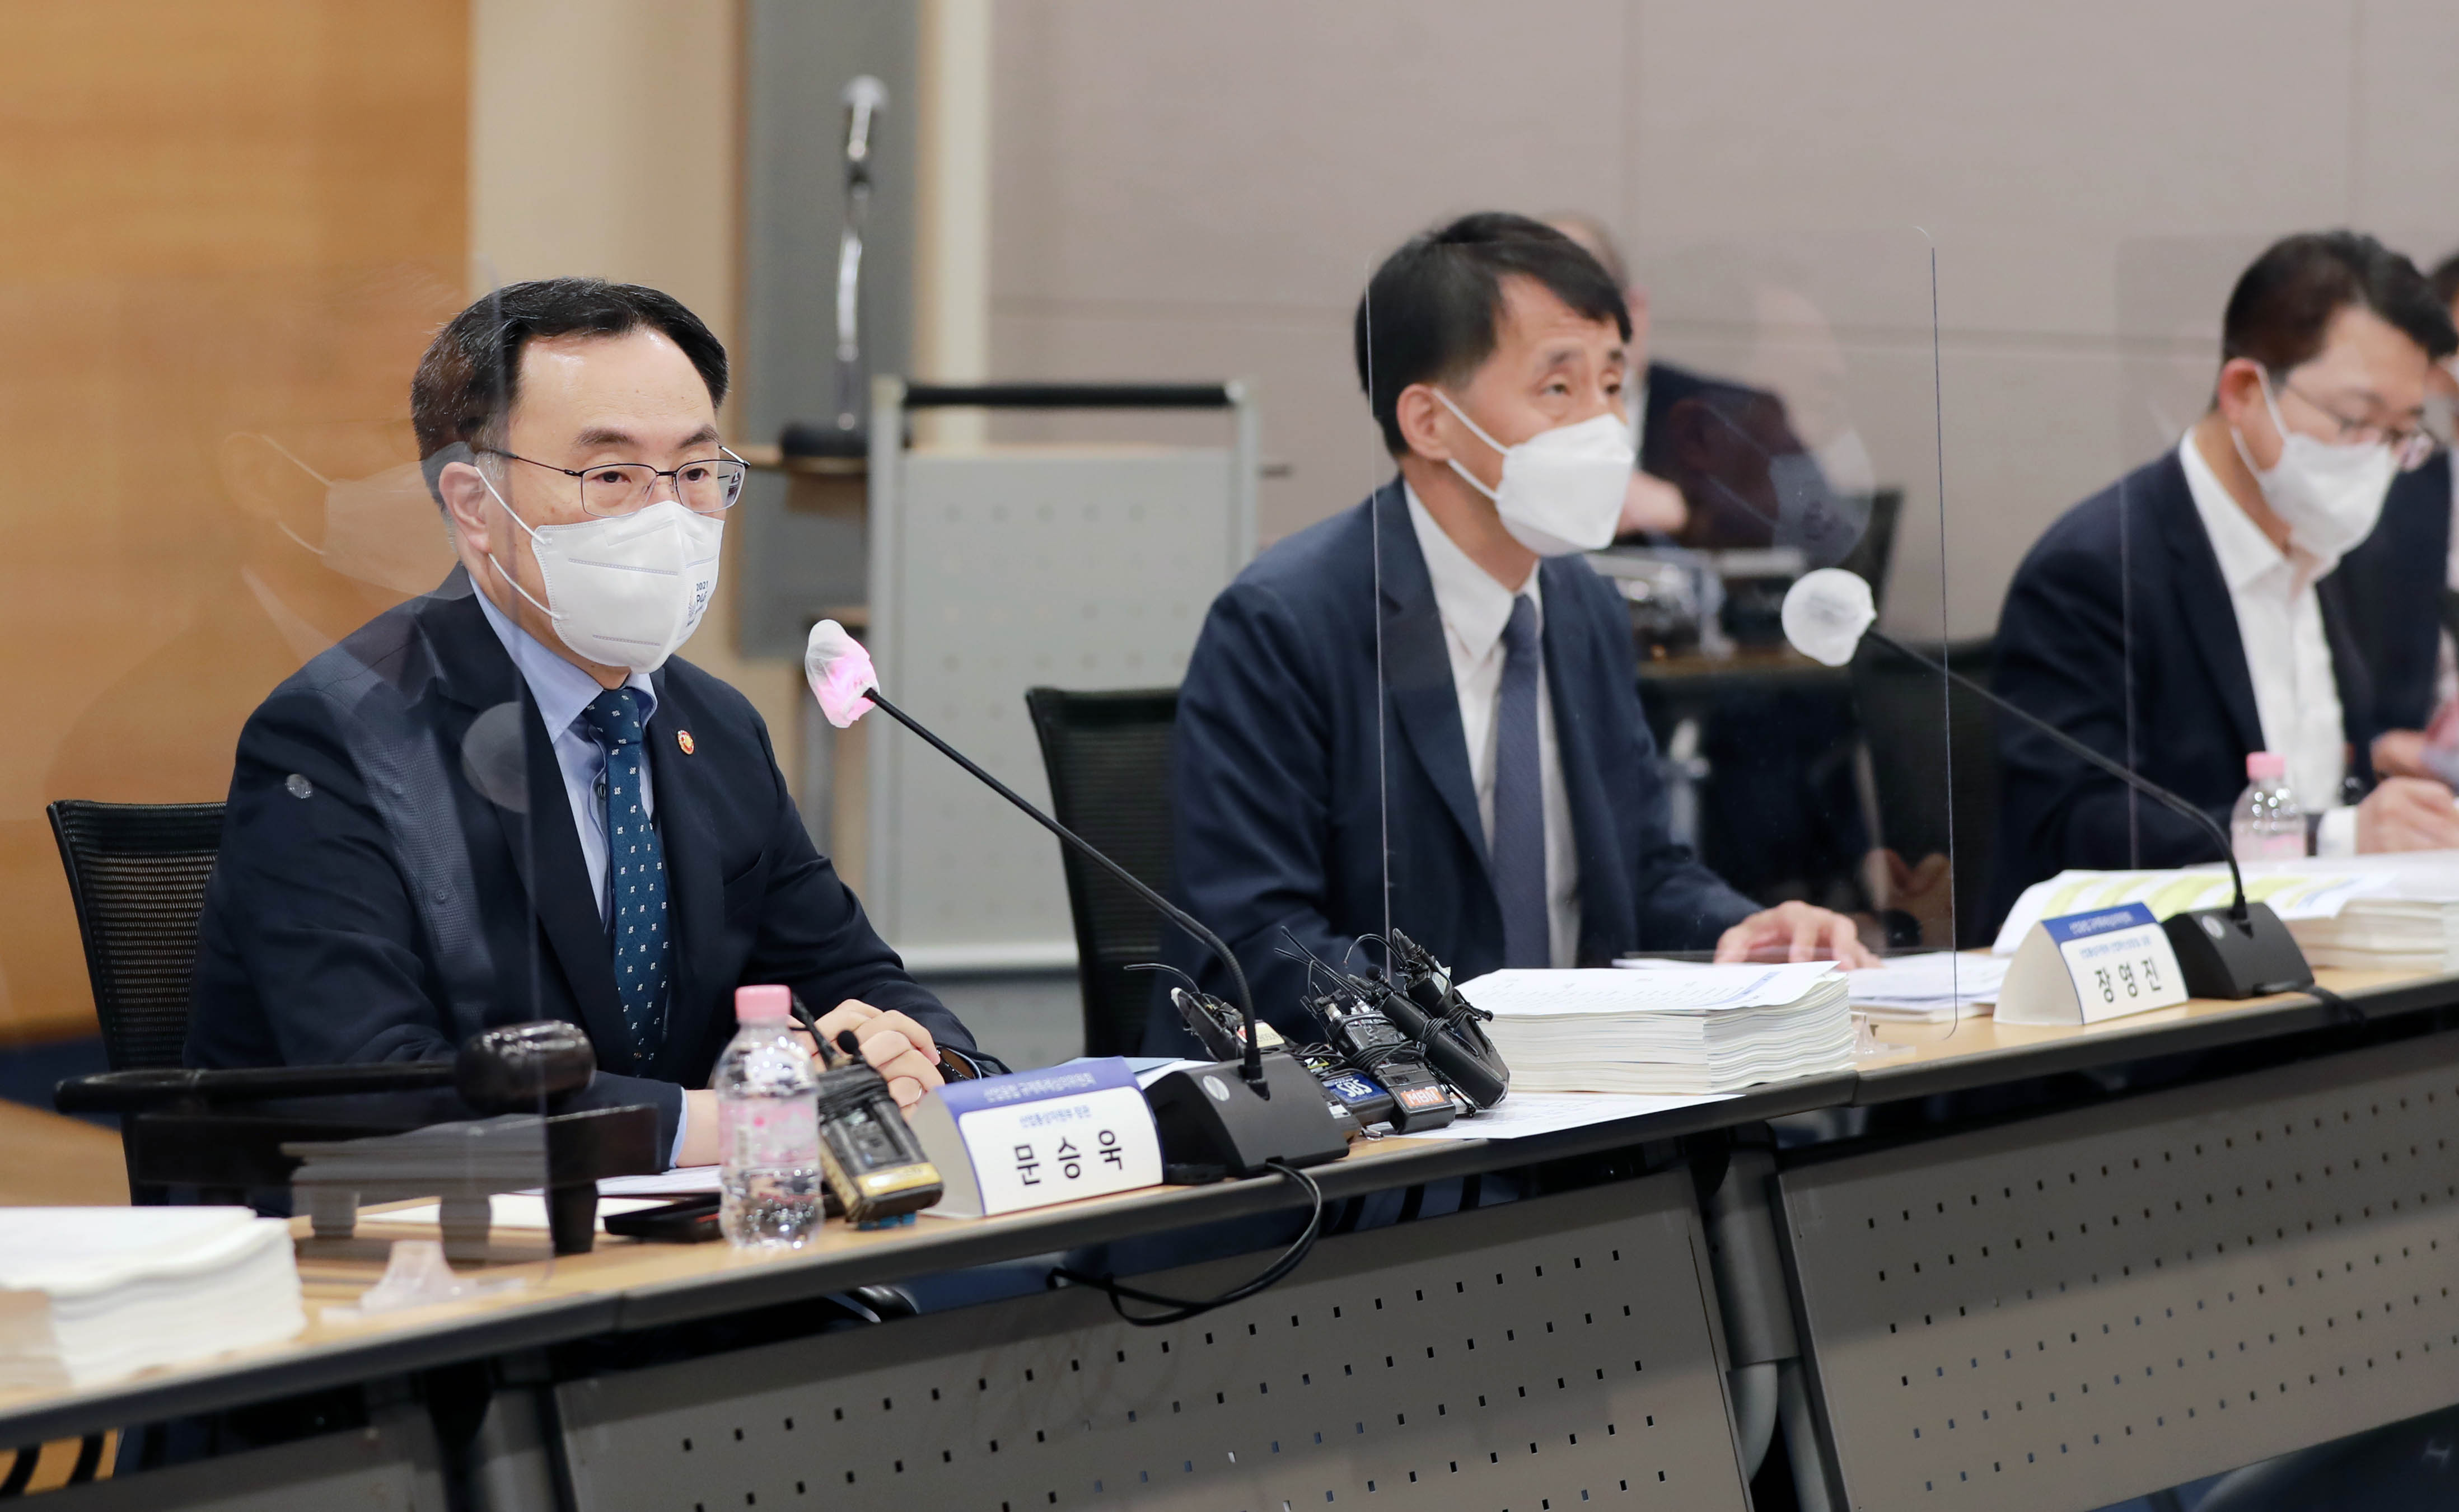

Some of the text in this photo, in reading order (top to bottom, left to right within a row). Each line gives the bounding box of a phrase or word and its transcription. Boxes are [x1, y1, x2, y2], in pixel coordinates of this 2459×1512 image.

[696, 581, 708, 591] 2021
[1336, 1079, 1373, 1098] SBS
[1406, 1091, 1440, 1104] MBN
